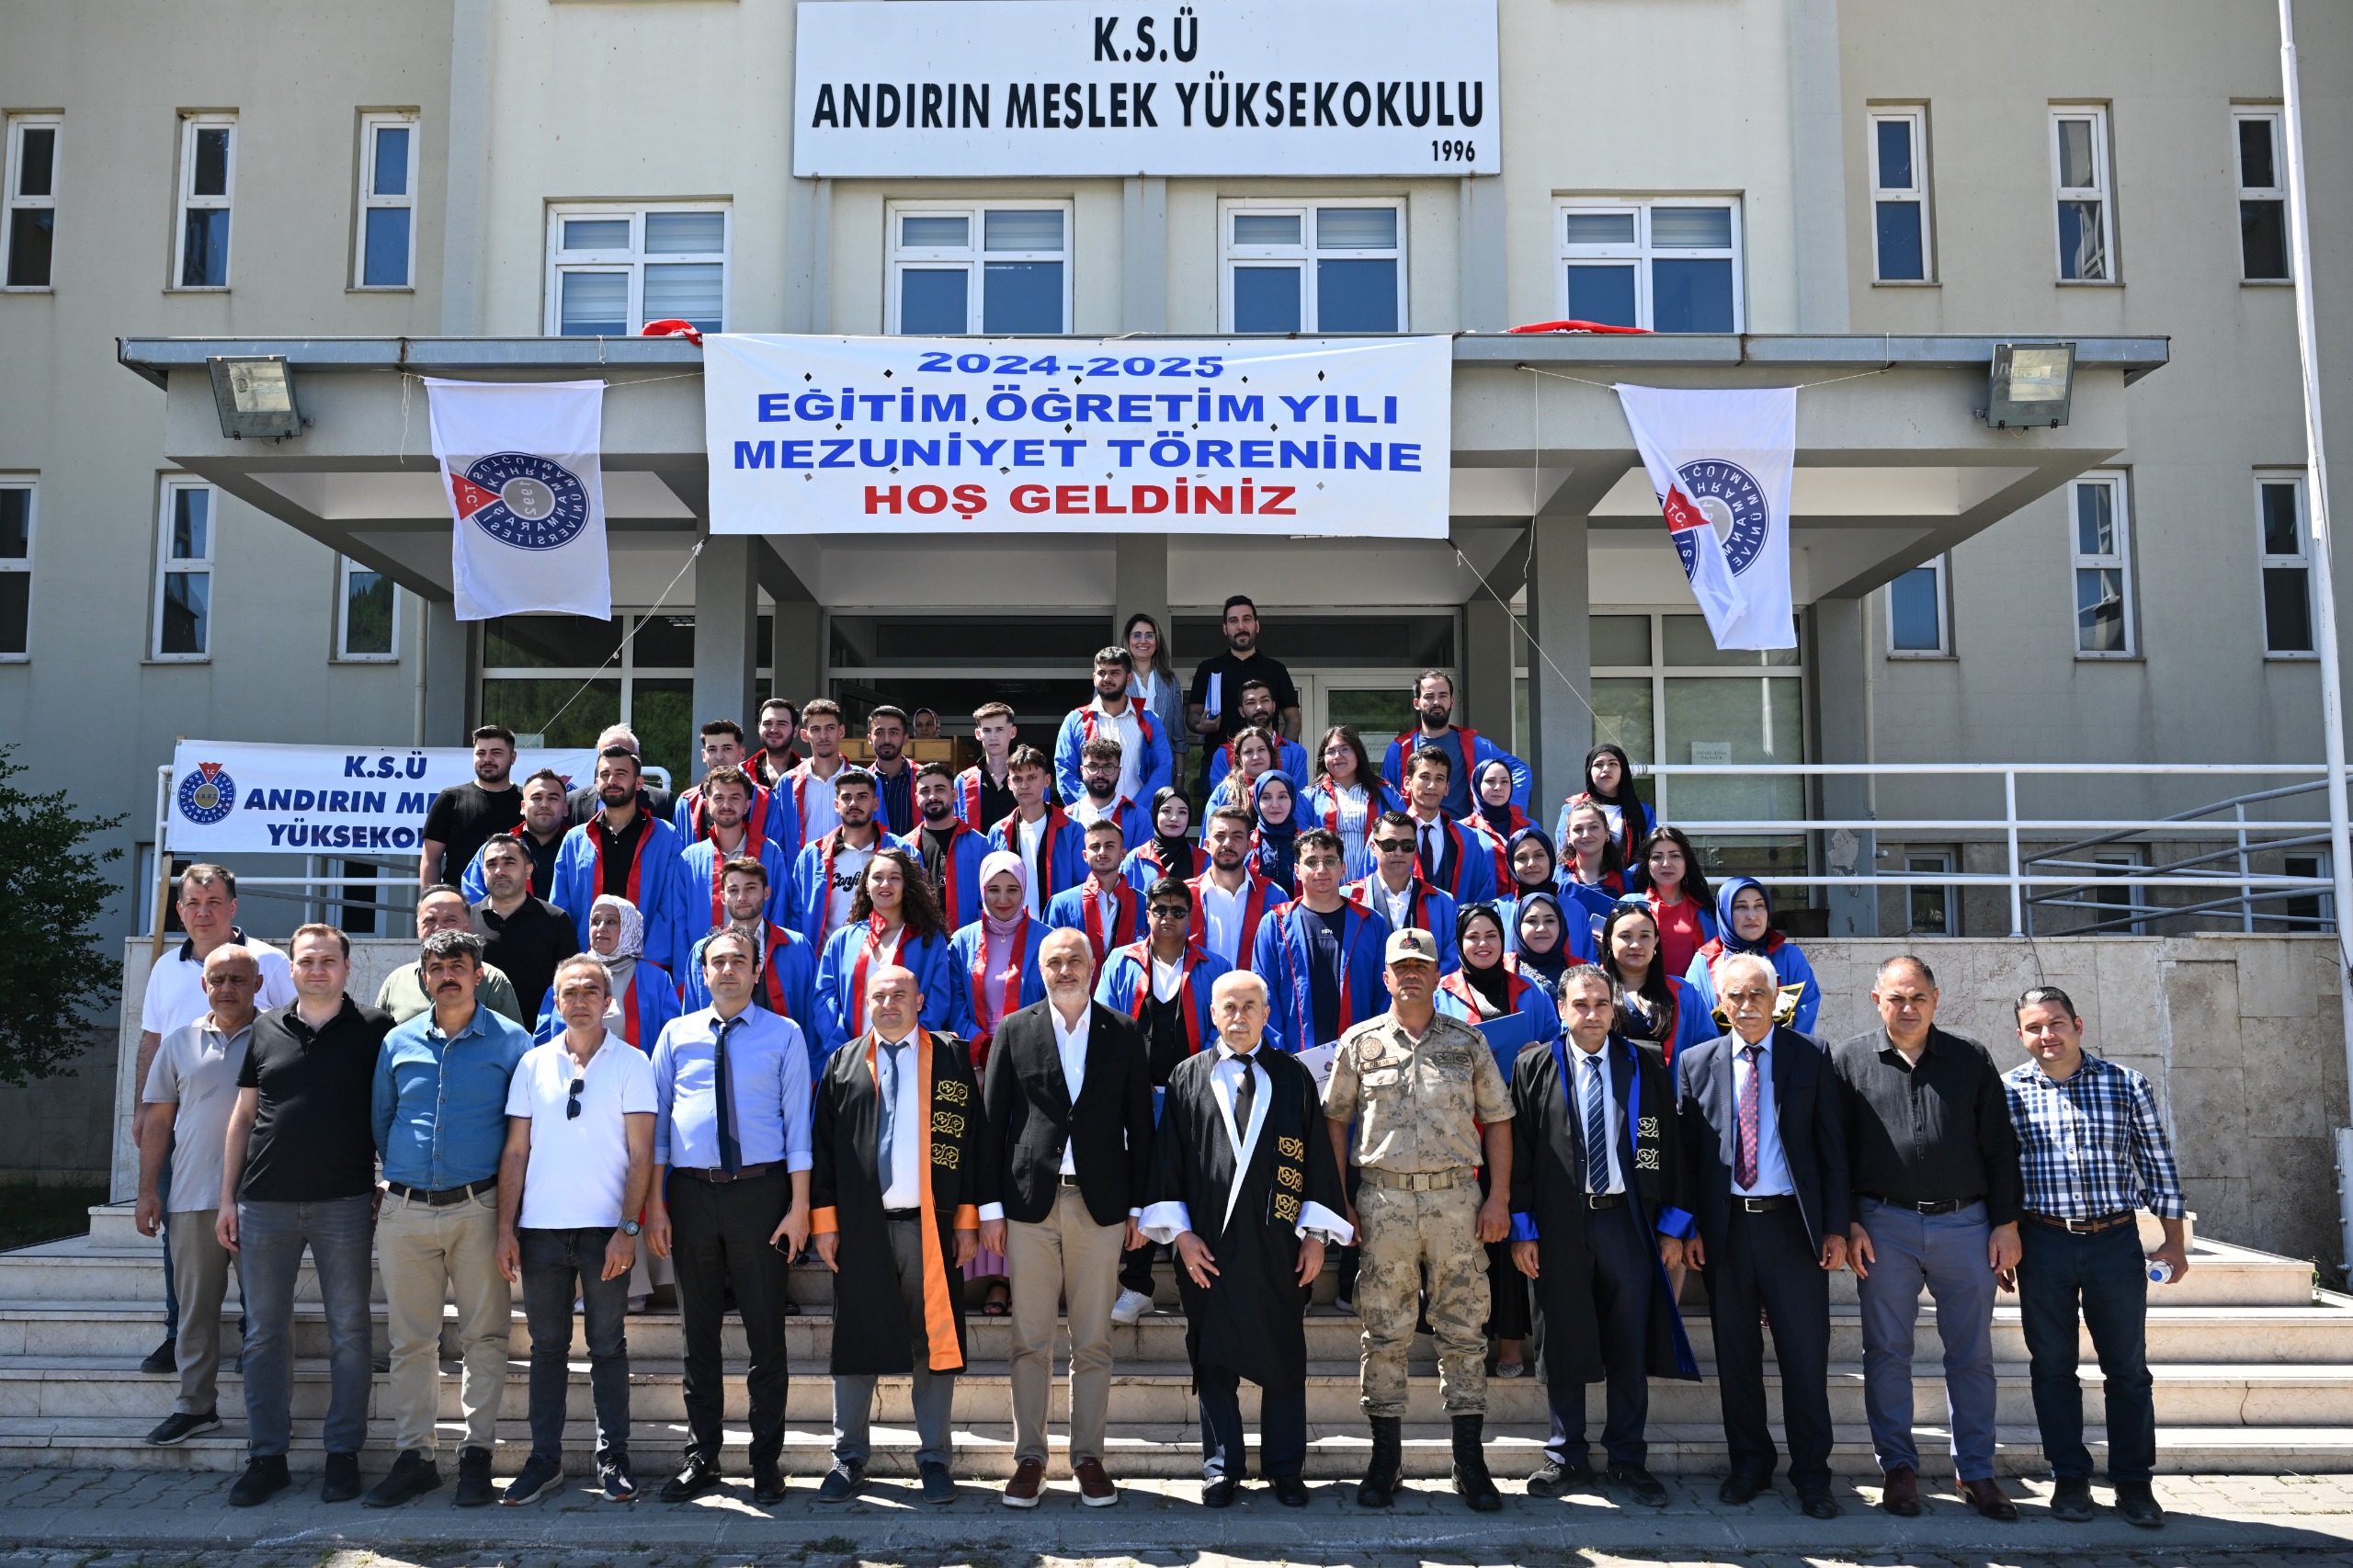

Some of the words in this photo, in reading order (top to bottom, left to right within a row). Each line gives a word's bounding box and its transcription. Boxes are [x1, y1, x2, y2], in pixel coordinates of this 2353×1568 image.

[1095, 6, 1197, 62] K.S.Ü
[813, 84, 989, 128] ANDIRIN
[1006, 82, 1157, 129] MESLEK
[1176, 71, 1482, 128] YÜKSEKOKULU
[1432, 140, 1475, 162] 1996
[917, 351, 1224, 379] 2024-2025
[758, 386, 966, 423] EĞİTİM
[986, 384, 1264, 423] ÖĞRETİM
[1279, 394, 1397, 425] YILI
[734, 431, 1087, 470] MEZUNİYET
[1108, 430, 1422, 472] TÖRENİNE
[864, 483, 987, 520] HOŞ
[1009, 476, 1297, 516] GELDİNİZ
[344, 750, 427, 779] K.S.Ü
[243, 788, 387, 813] ANDIRIN
